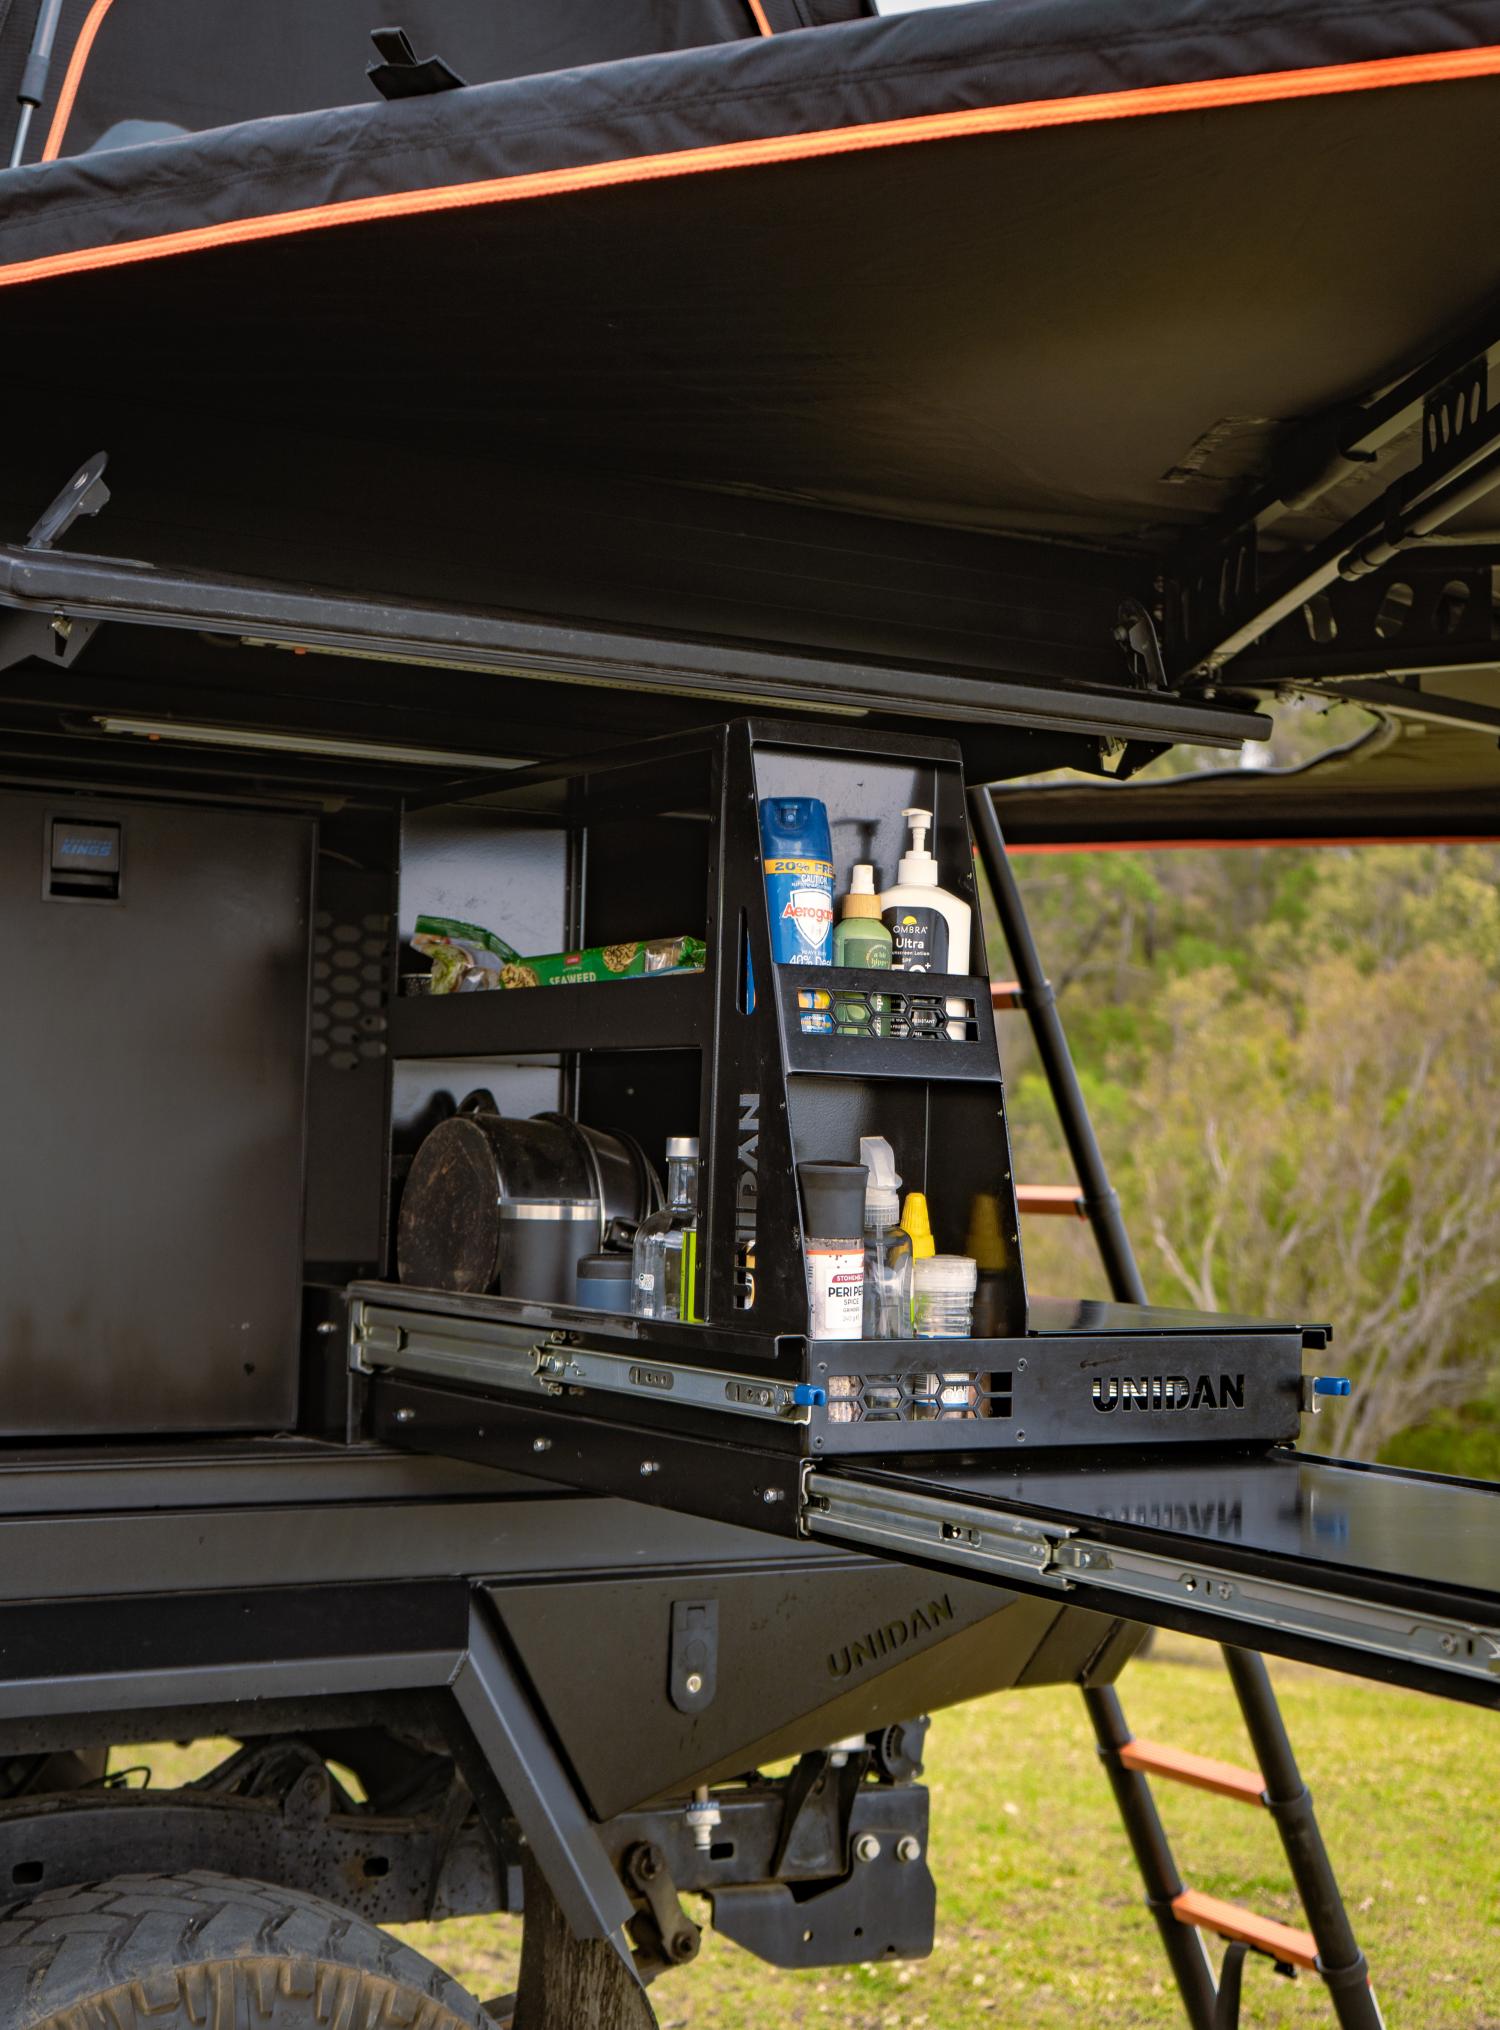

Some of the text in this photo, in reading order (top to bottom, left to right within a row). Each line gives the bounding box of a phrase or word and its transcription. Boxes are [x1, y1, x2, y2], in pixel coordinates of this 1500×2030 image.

[774, 861, 833, 875] 20% FRE
[893, 925, 927, 934] OMBRA
[896, 937, 925, 949] Ultra
[549, 971, 597, 985] SEAWEED
[828, 1286, 852, 1298] PERI
[843, 1298, 859, 1306] SPICE
[1092, 1374, 1245, 1414] UNIDAN
[828, 1593, 954, 1678] UNIDAN
